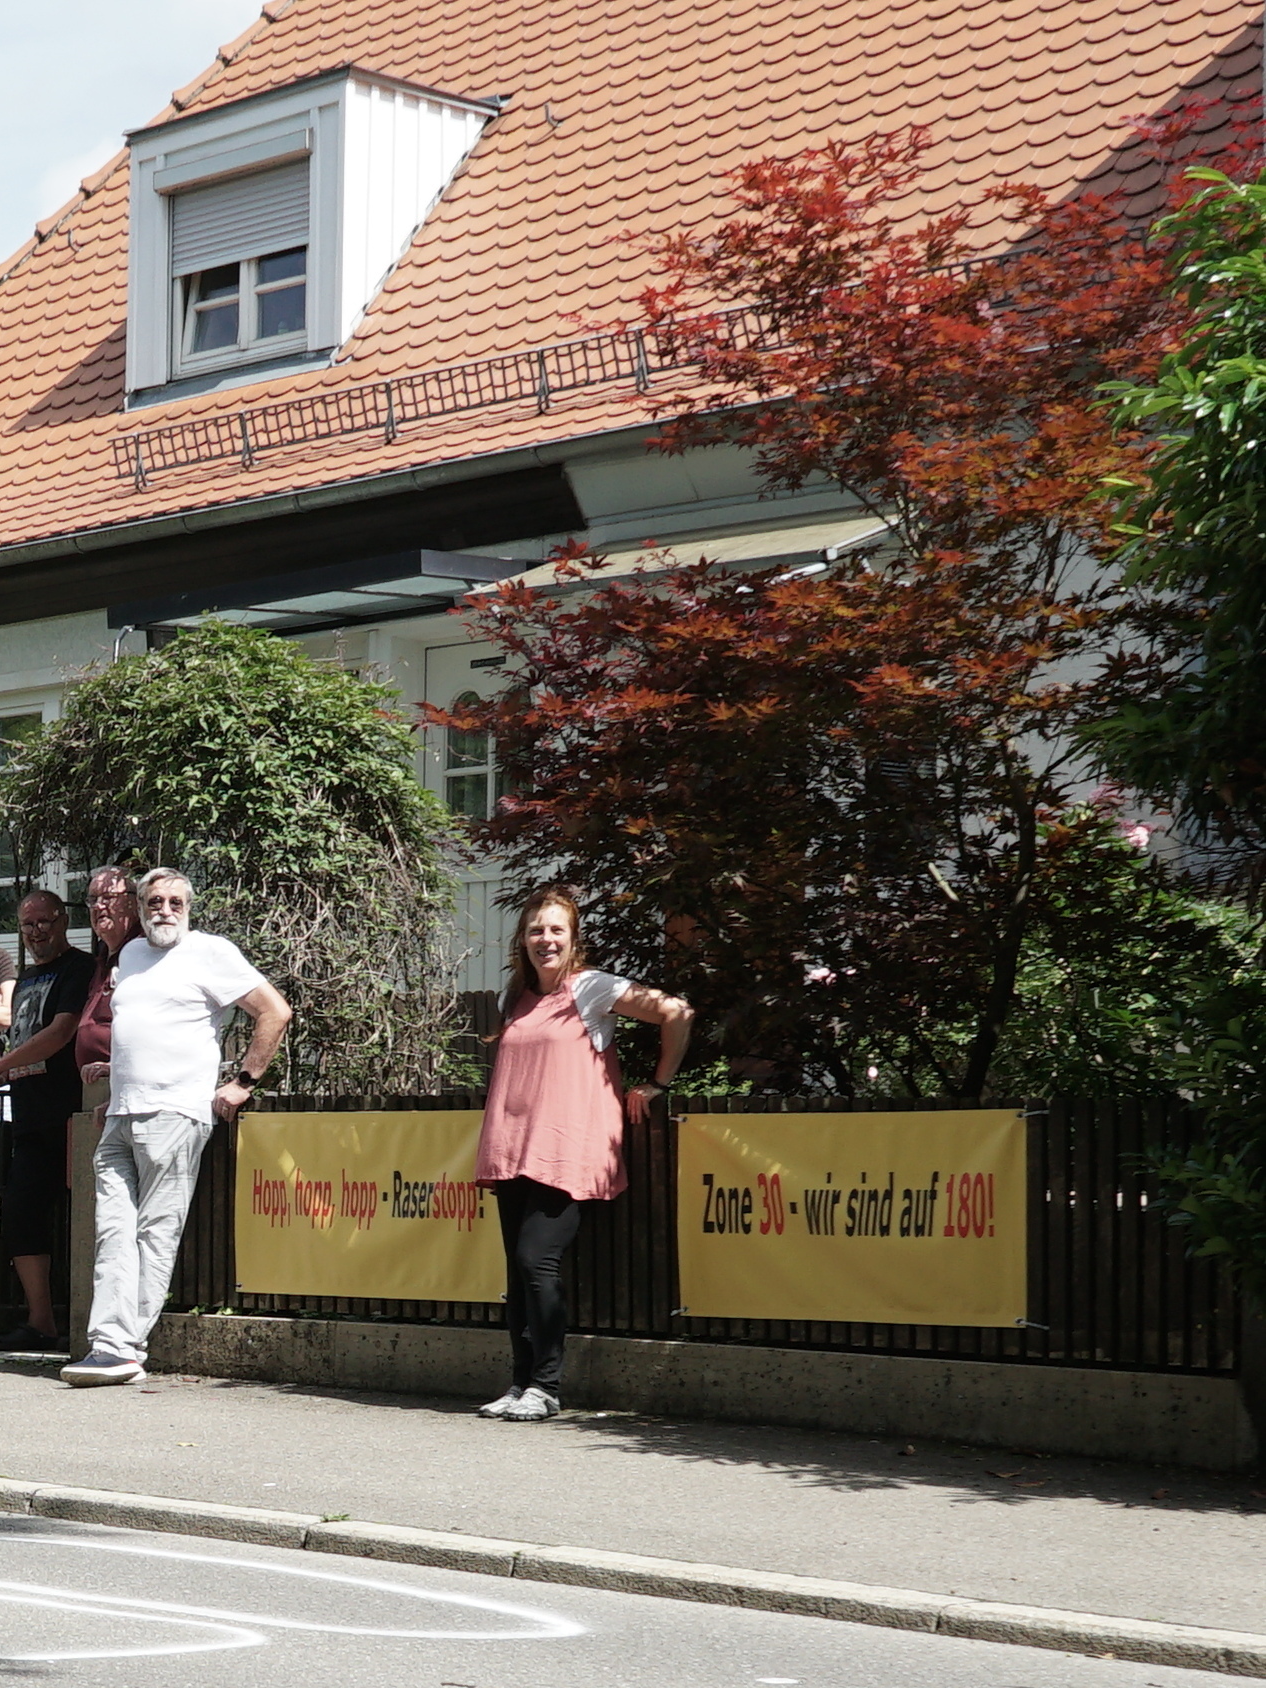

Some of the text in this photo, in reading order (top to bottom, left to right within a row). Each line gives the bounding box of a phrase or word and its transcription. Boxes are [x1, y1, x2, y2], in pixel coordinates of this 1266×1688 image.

[253, 1169, 291, 1228] Hopp,
[295, 1168, 336, 1229] hopp,
[340, 1168, 378, 1230] hopp
[392, 1170, 484, 1232] Raserstopp!
[702, 1173, 753, 1235] Zone
[757, 1172, 784, 1236] 30
[804, 1171, 842, 1236] wir
[845, 1171, 895, 1237] sind
[899, 1170, 939, 1237] auf
[943, 1172, 996, 1238] 180!
